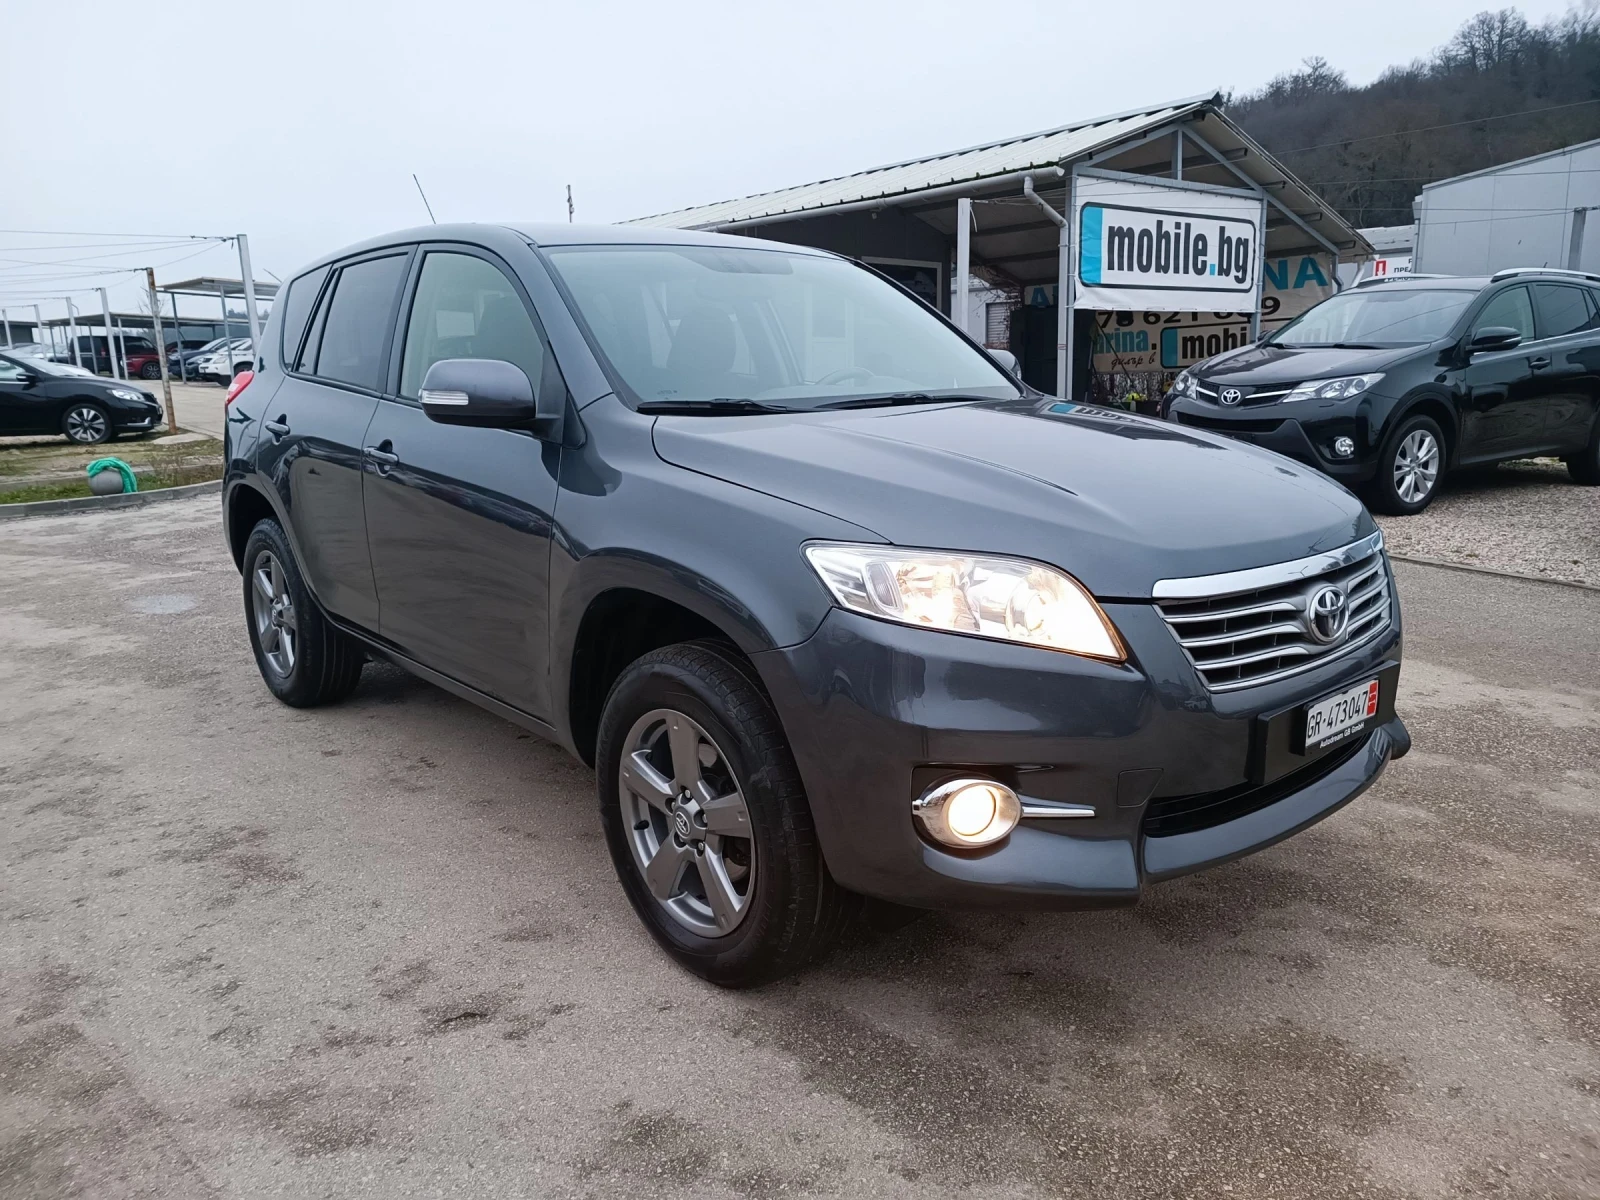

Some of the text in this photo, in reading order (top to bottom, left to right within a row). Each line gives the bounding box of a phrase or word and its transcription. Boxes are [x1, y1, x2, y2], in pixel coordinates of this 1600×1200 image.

[1107, 219, 1249, 285] mobile.bg
[1319, 733, 1344, 749] Autodream
[1351, 722, 1365, 734] GmbH
